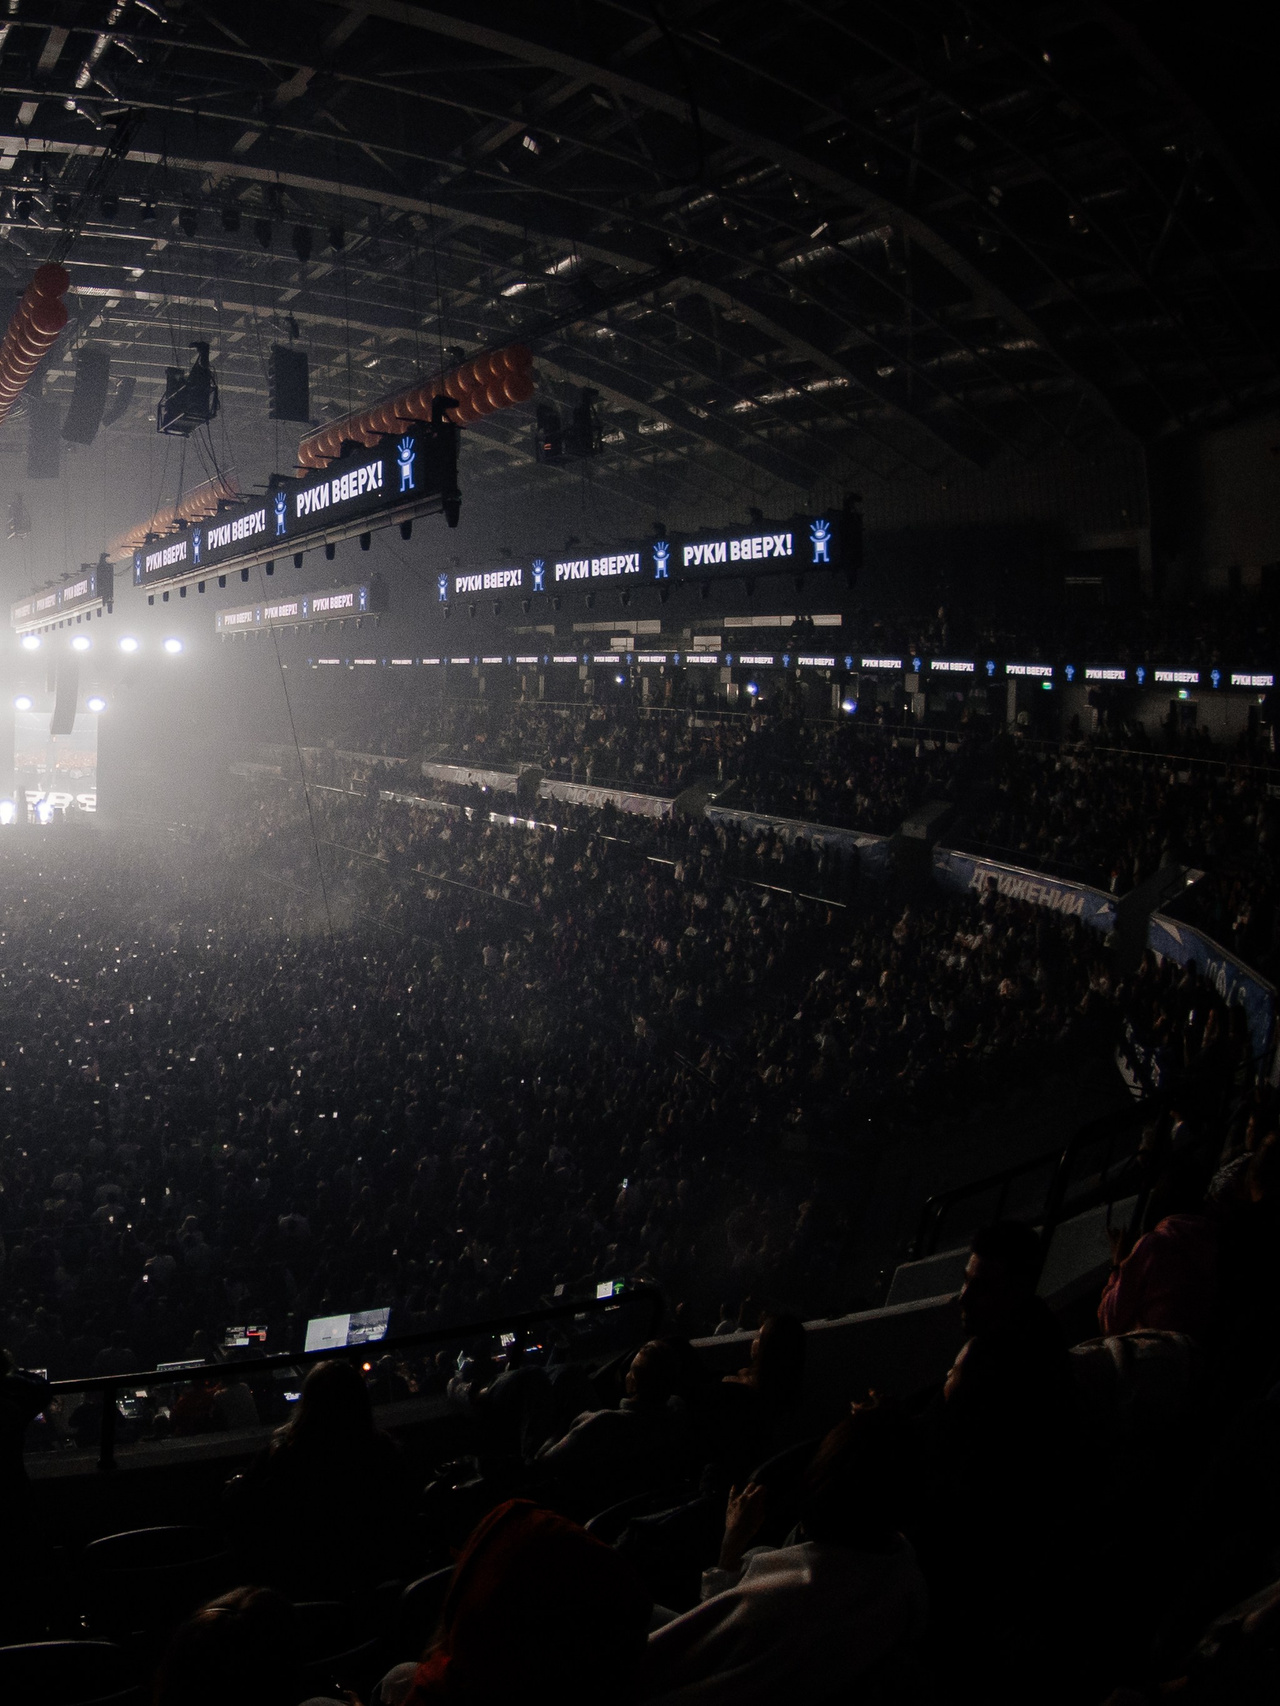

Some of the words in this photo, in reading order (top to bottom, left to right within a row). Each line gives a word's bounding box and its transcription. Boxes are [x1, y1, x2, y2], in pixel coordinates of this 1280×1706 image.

[296, 482, 330, 518] РУКИ
[207, 523, 231, 551] РУКИ
[145, 550, 161, 573] РУКИ
[683, 542, 727, 567] РУКИ
[555, 560, 589, 581] РУКИ
[455, 574, 482, 593] РУКИ
[862, 659, 878, 668] РУКИ
[931, 662, 949, 671] РУКИ
[1006, 665, 1025, 676] РУКИ
[1086, 669, 1102, 679] РУКИ
[1155, 671, 1173, 682] РУКИ
[1232, 675, 1251, 686] РУКИ
